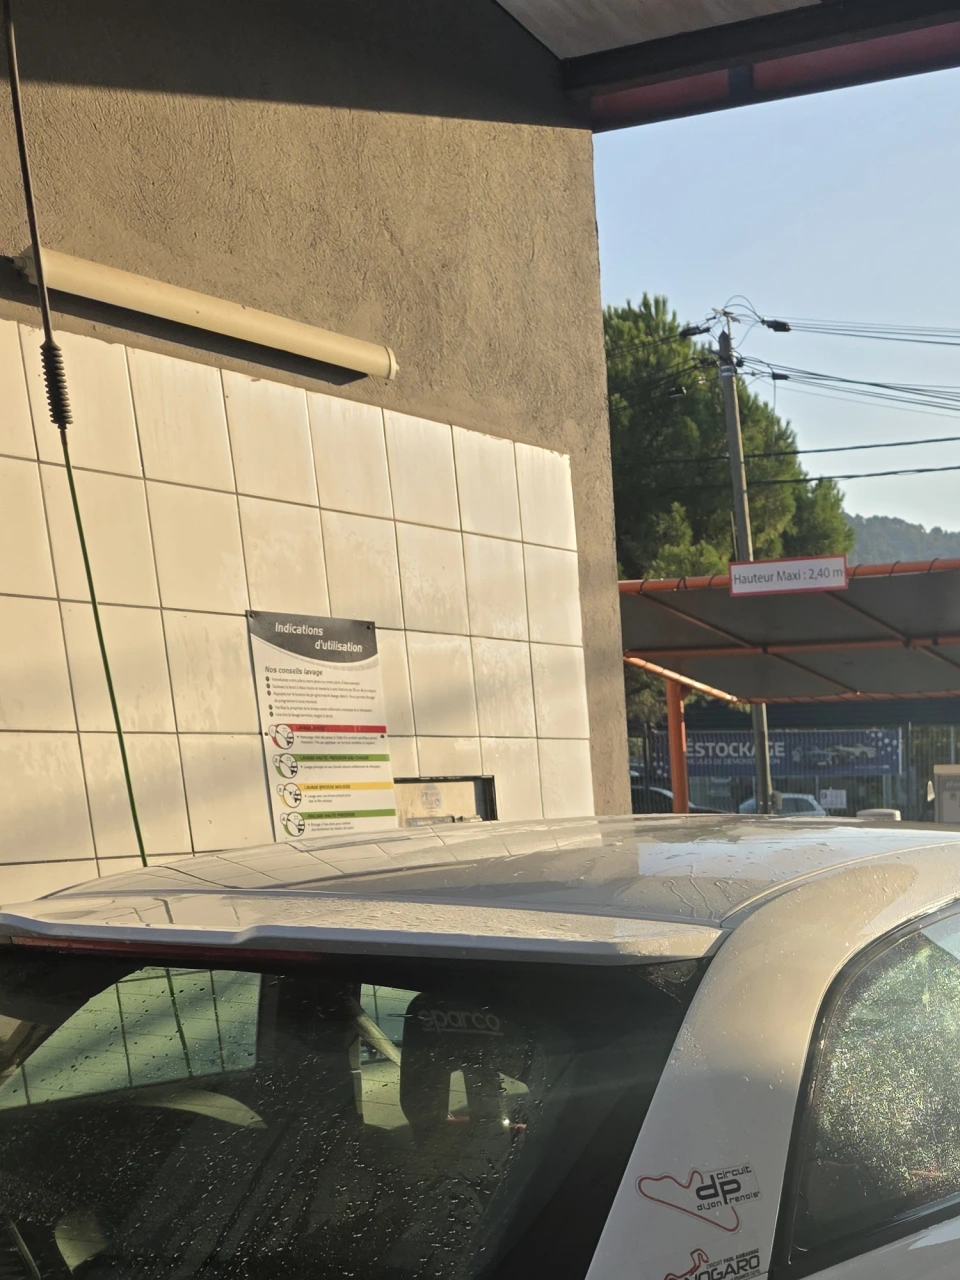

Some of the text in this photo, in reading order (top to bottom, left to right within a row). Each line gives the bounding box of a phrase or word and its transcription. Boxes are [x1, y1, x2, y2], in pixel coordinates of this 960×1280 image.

[733, 573, 774, 585] Hauteur
[776, 570, 801, 582] Maxi
[808, 567, 831, 581] 2,40
[832, 568, 843, 578] m
[275, 621, 324, 637] Indications
[314, 639, 363, 653] d'utilisation
[264, 665, 323, 677] Nos conseils lavage
[417, 1009, 501, 1034] sparco
[716, 1165, 752, 1180] circuit
[697, 1201, 722, 1211] dijon
